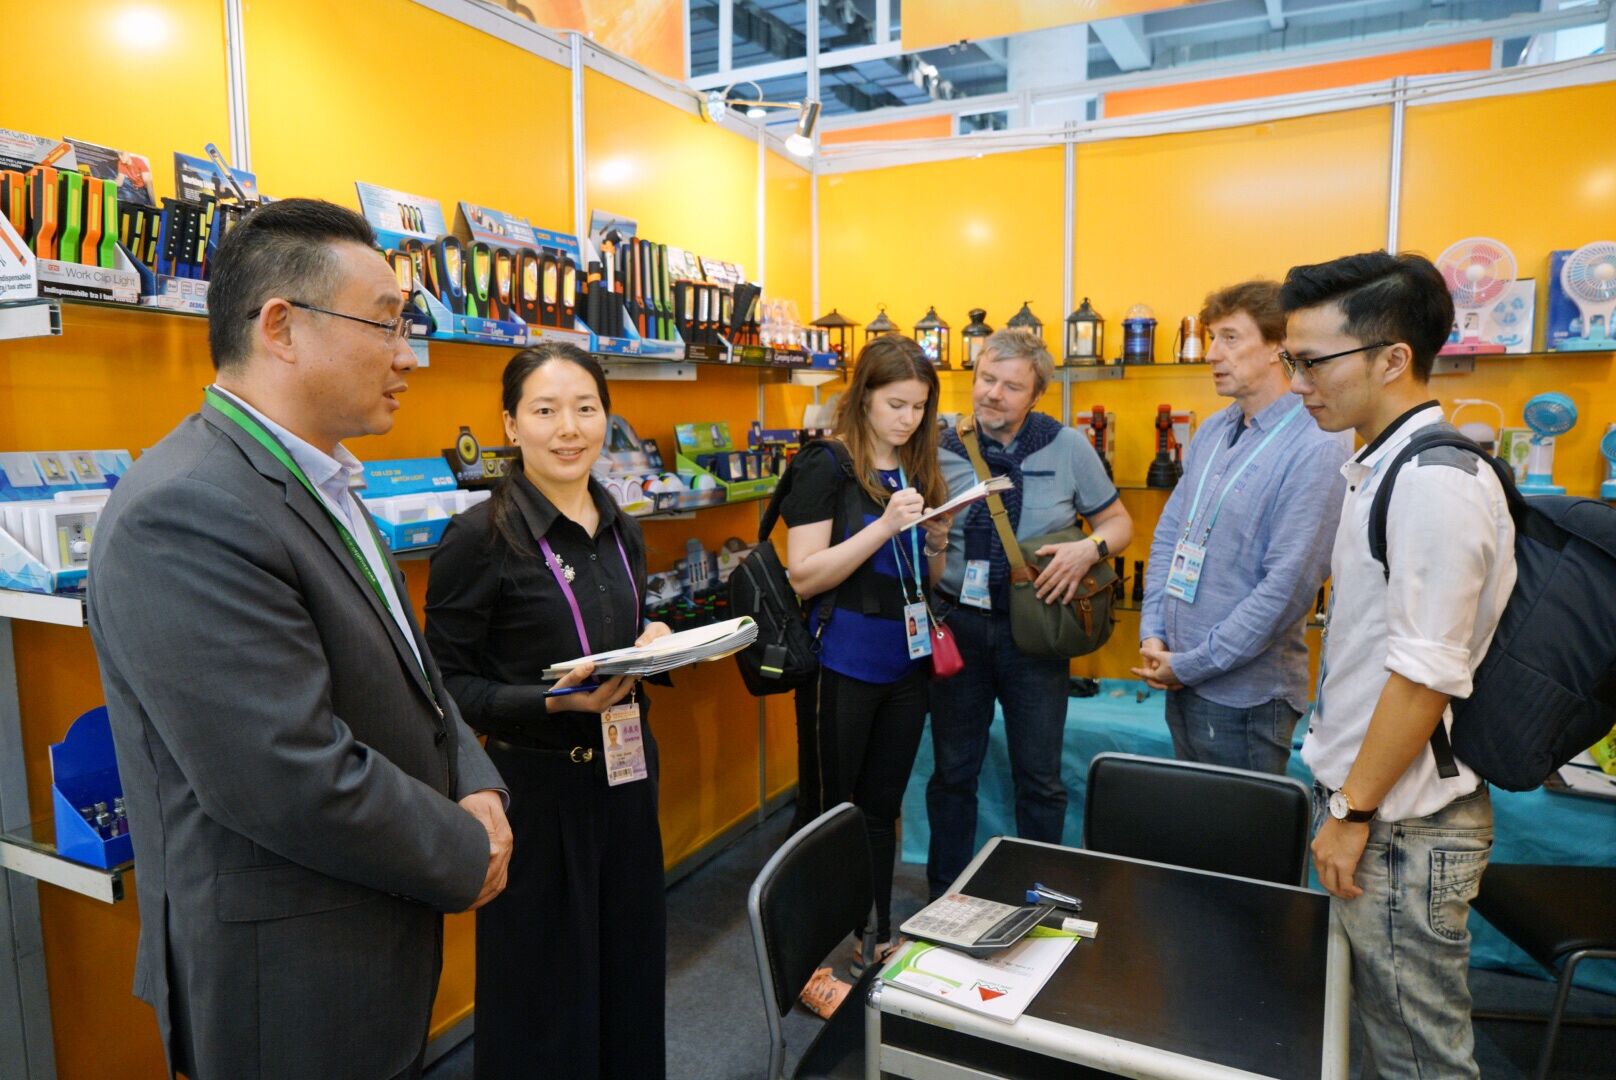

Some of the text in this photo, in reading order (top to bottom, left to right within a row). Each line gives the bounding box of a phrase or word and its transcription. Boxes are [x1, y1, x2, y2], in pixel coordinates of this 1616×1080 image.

[65, 267, 92, 280] Work
[93, 271, 112, 284] Clip
[113, 274, 136, 288] Light
[44, 286, 89, 298] Indispensabile
[89, 291, 99, 299] tra
